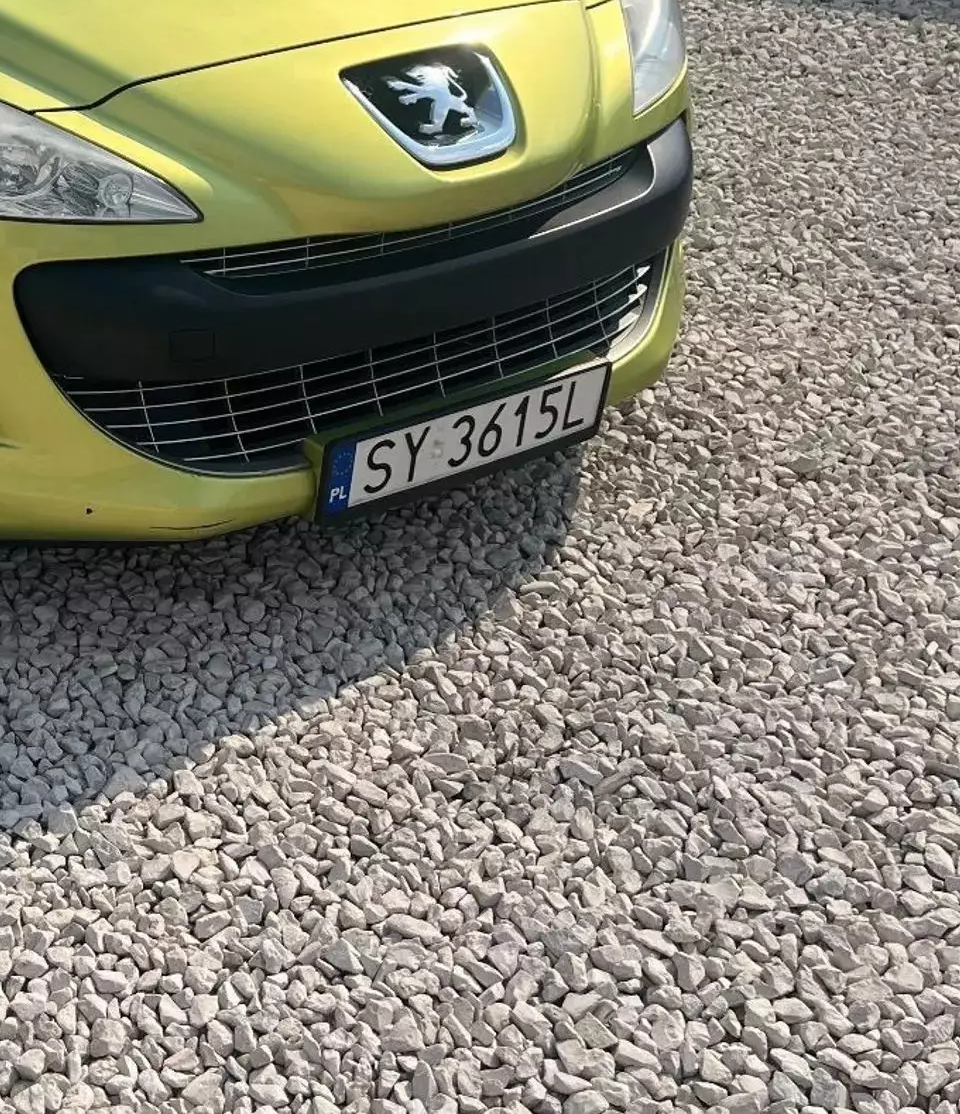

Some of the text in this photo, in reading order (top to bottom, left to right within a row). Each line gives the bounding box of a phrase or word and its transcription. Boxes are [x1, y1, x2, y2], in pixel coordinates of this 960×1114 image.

[363, 380, 585, 494] SY 3615L
[328, 486, 348, 503] PL
